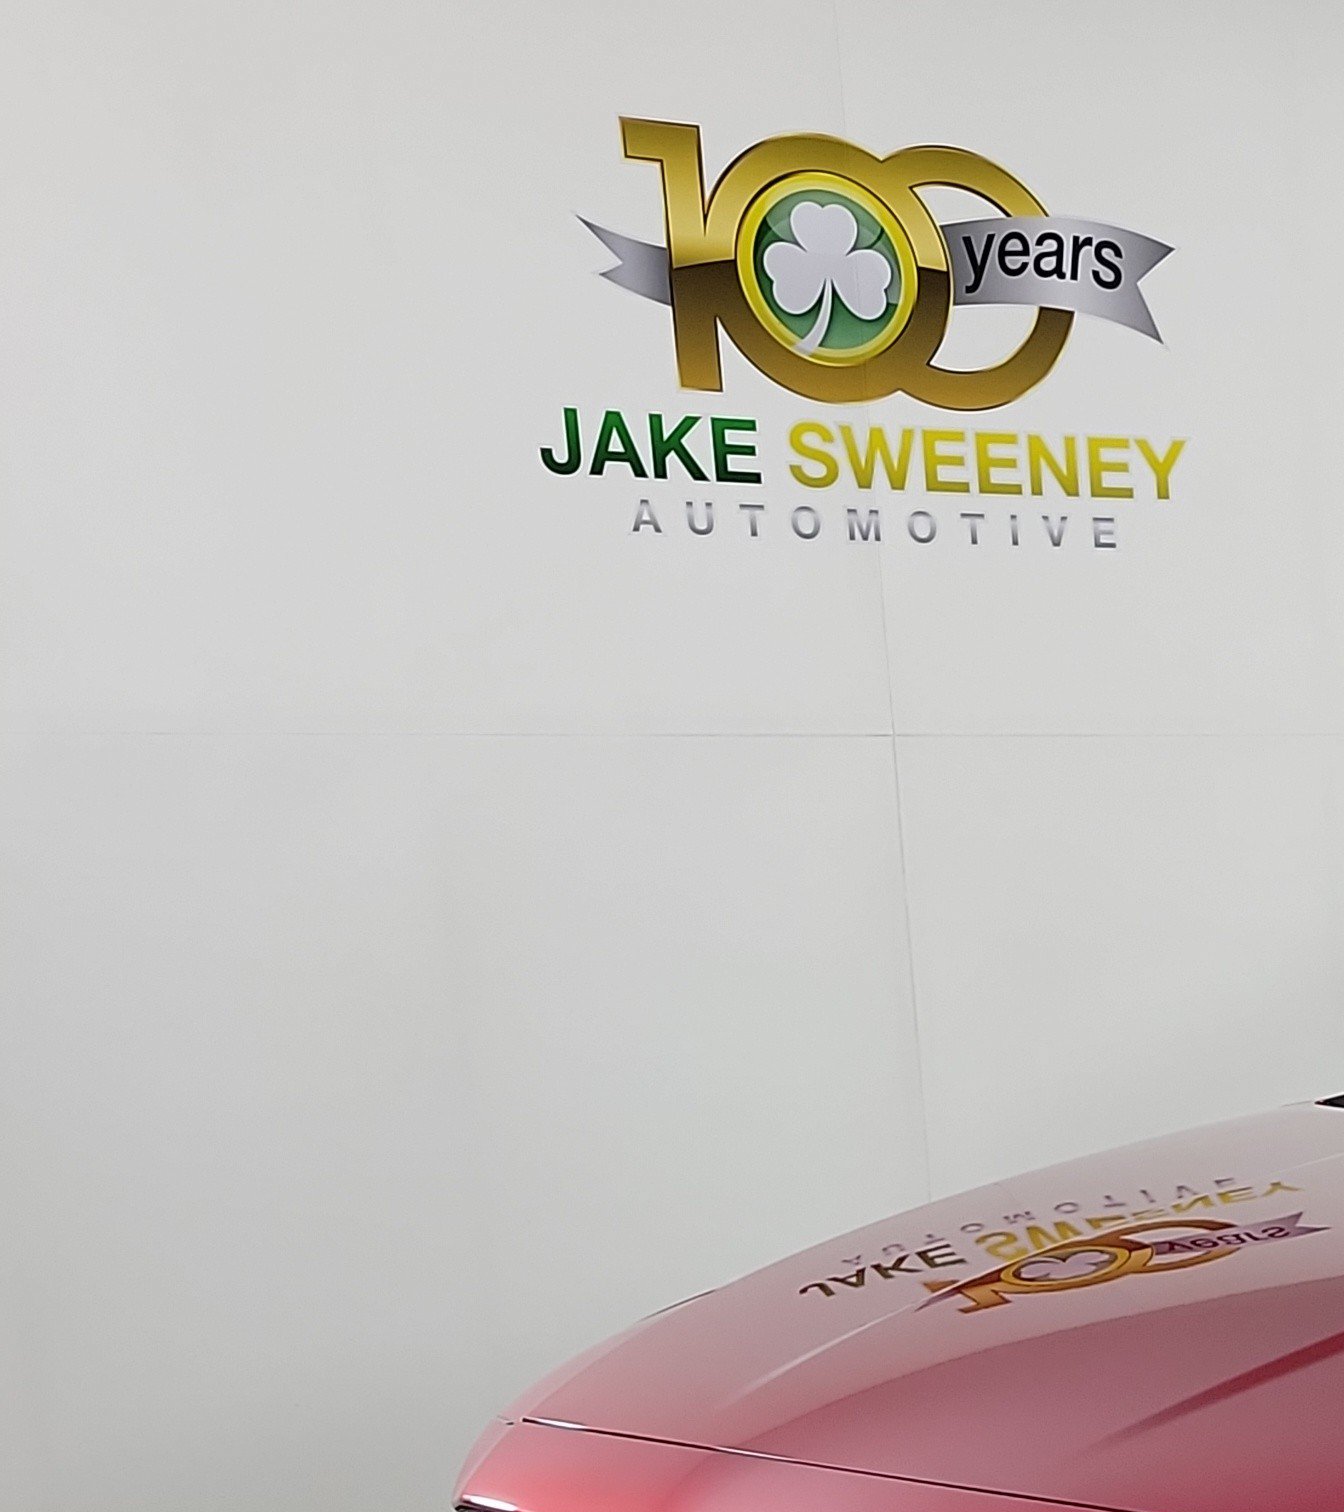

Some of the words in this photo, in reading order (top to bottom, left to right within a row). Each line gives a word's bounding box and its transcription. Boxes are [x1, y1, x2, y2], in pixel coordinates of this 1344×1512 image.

[618, 115, 1076, 412] 100
[961, 226, 1124, 294] years
[539, 407, 763, 485] JAKE
[788, 421, 1186, 500] SWEENEY
[630, 498, 1118, 549] AUTOMOTIVE
